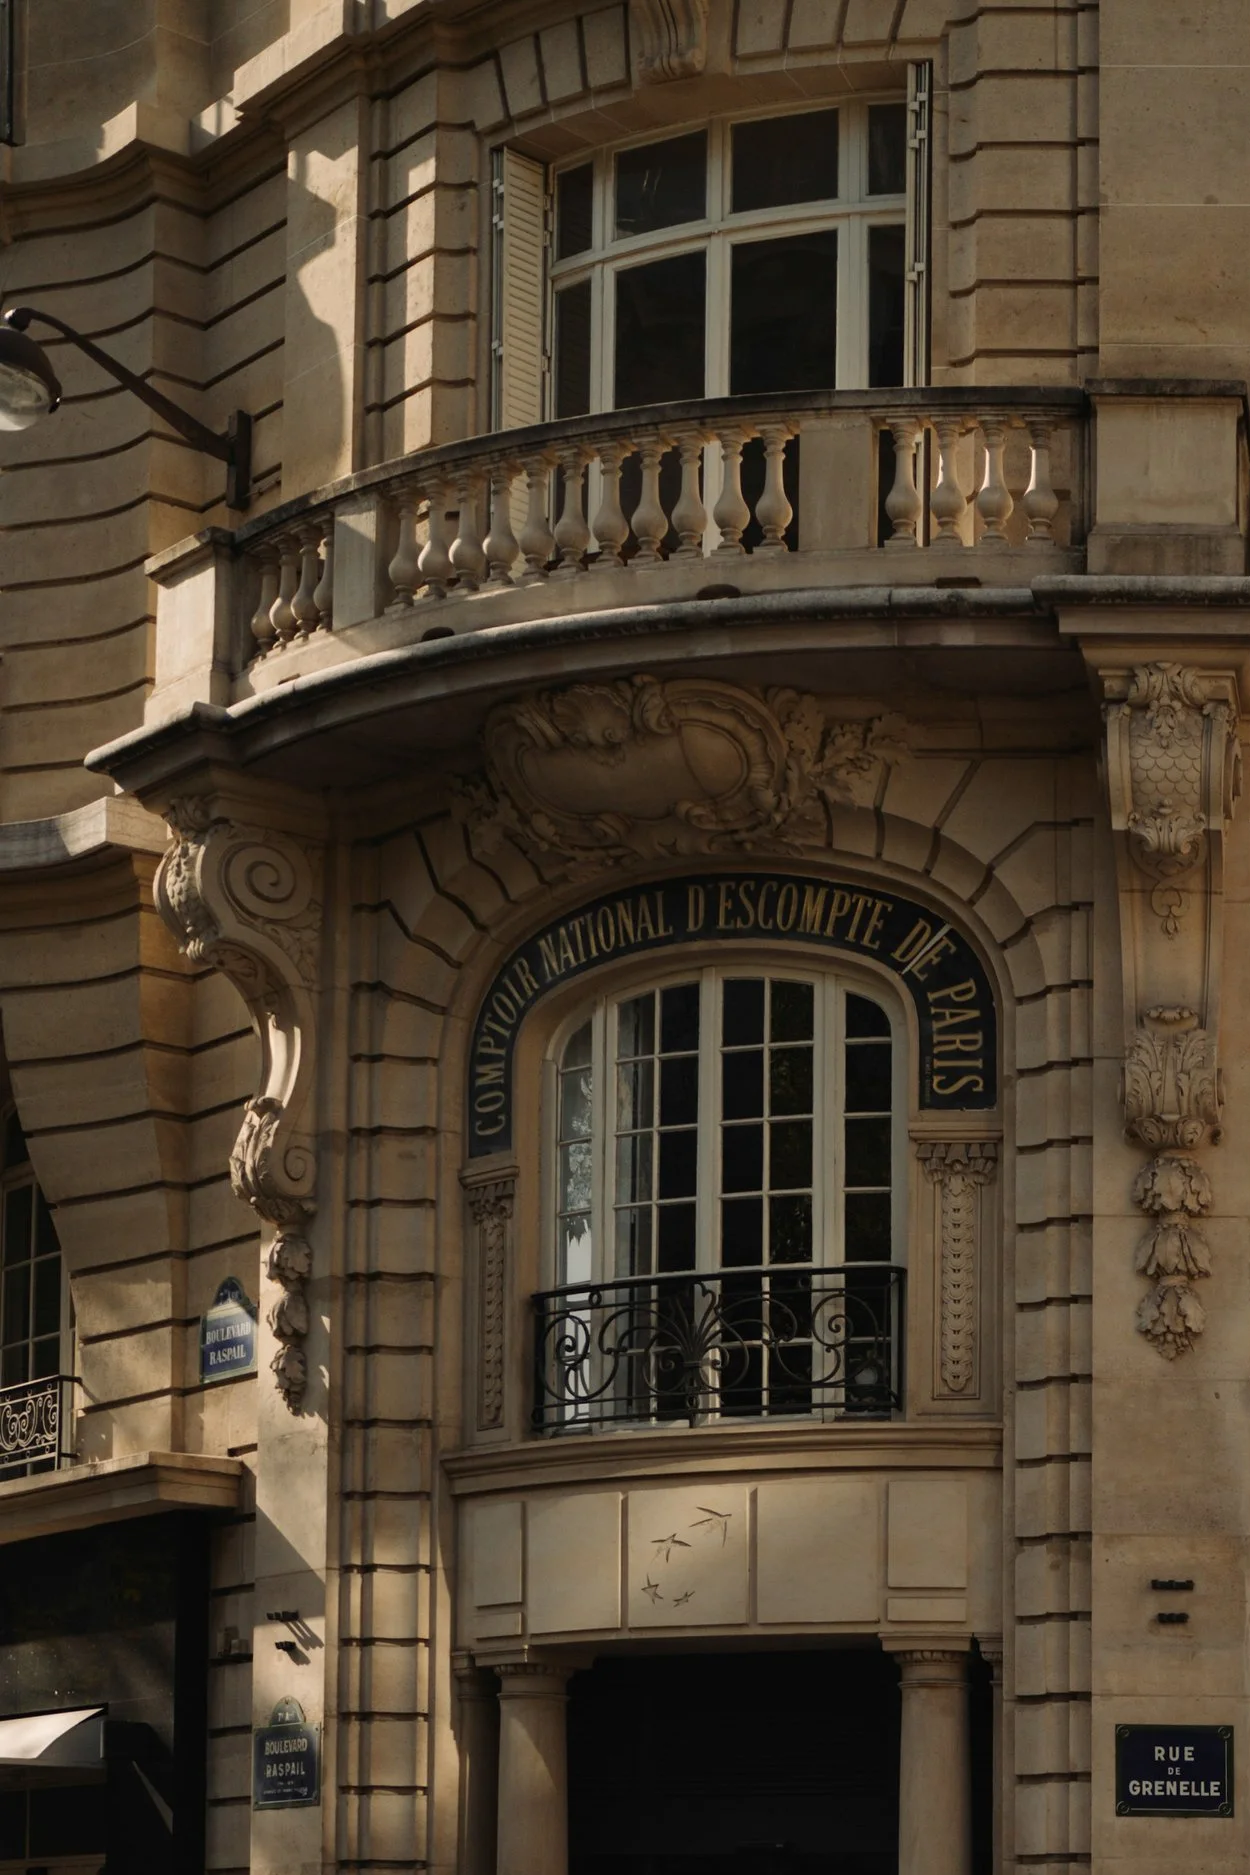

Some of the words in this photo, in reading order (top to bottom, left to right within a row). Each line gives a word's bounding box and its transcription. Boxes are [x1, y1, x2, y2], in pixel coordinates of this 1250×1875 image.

[474, 956, 540, 1137] COMPTOIR
[536, 890, 674, 983] NATIONAL
[890, 917, 957, 982] DE
[926, 977, 985, 1096] PARIS
[205, 1321, 252, 1345] BOULEVARD
[209, 1343, 247, 1366] RASPAIL
[264, 1737, 308, 1756] BOULEVARD
[1153, 1745, 1195, 1762] RUE
[265, 1761, 306, 1779] RASPAIL
[1167, 1767, 1181, 1776] DE
[1128, 1780, 1221, 1797] GRENELLE
